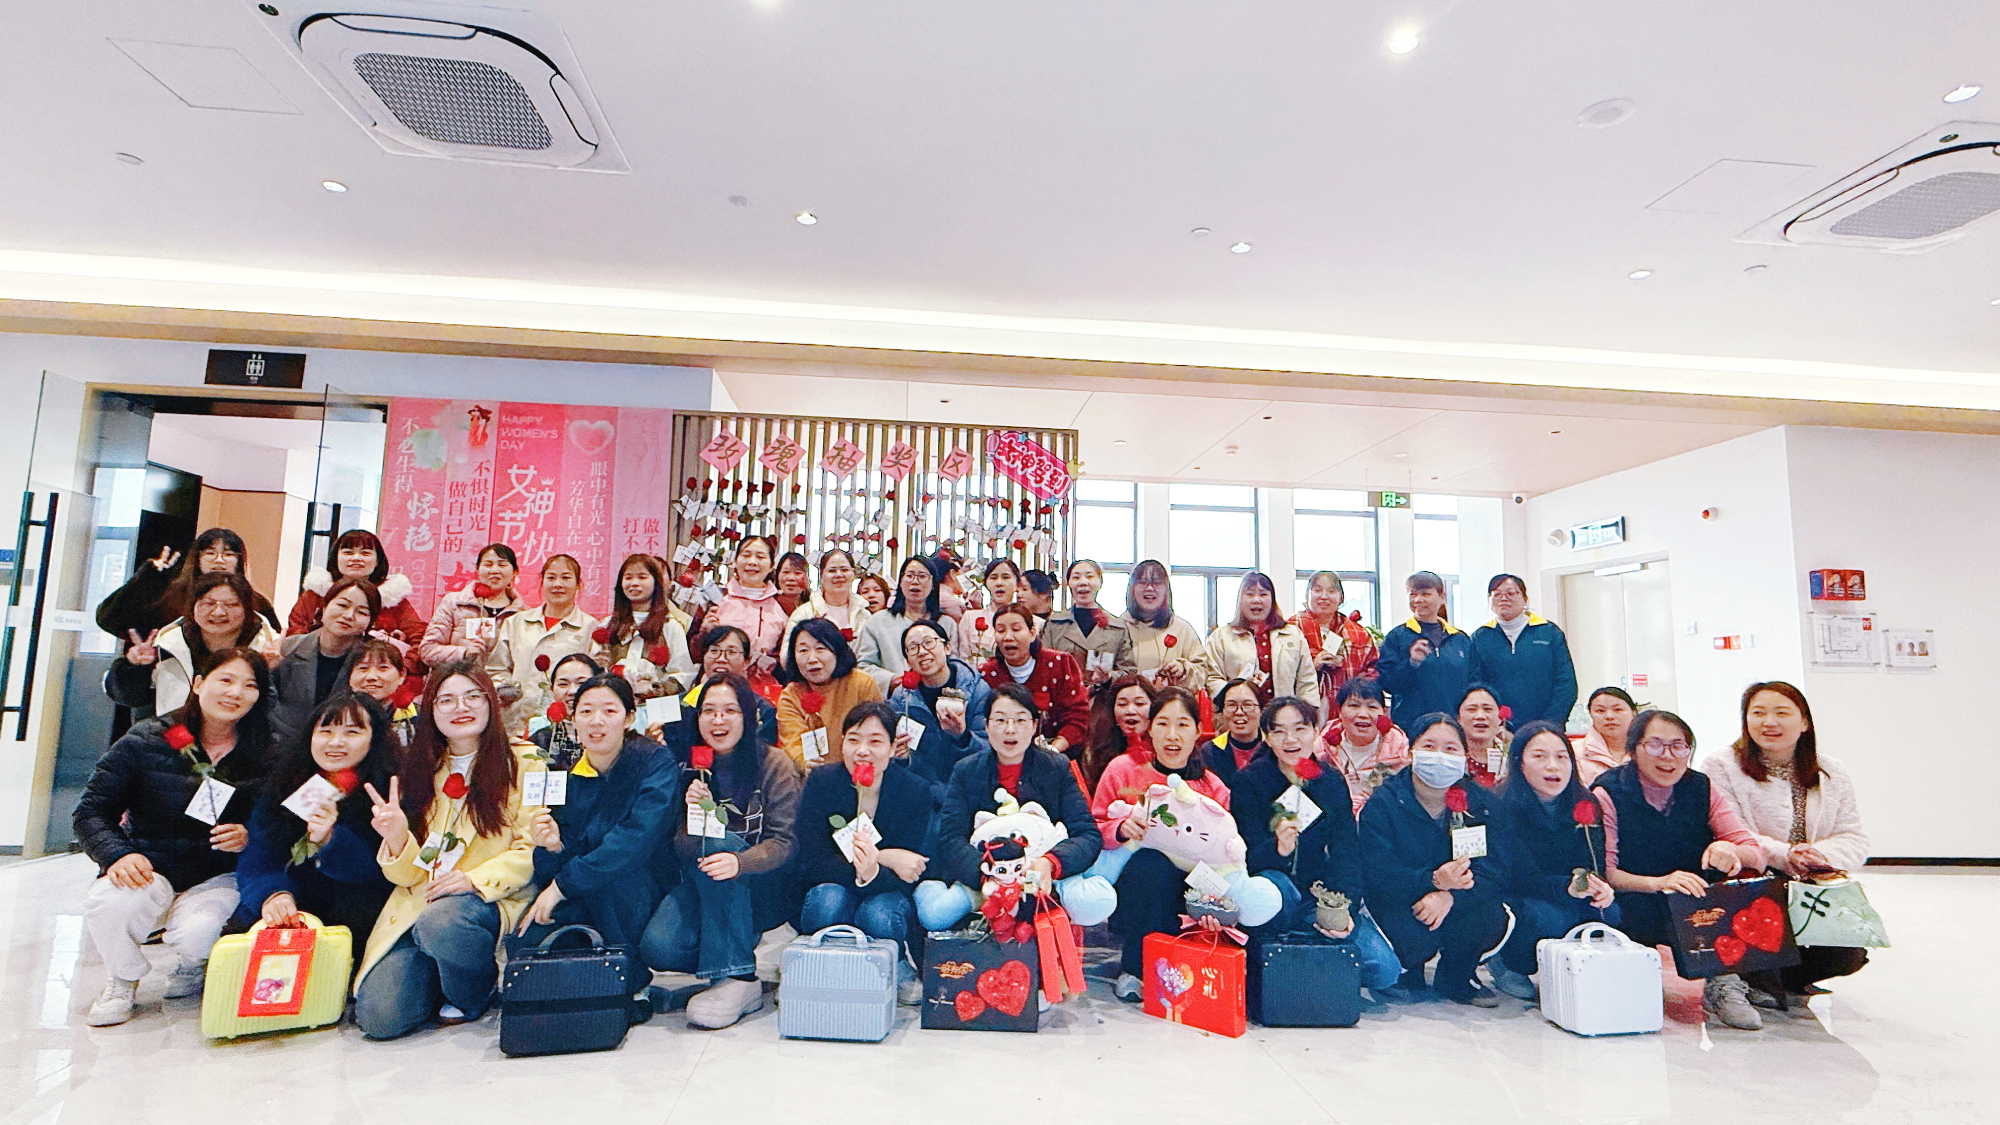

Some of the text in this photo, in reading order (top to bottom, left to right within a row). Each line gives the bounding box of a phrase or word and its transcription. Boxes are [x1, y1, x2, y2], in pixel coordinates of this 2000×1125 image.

[500, 440, 526, 450] DAY
[501, 428, 558, 439] WOMEN'S
[996, 438, 1070, 495] 女神驾到
[444, 481, 467, 553] 做自己的
[468, 460, 490, 532] 不惧时光
[403, 491, 439, 552] 惊艳
[644, 518, 660, 557] 做不
[1201, 967, 1218, 999] 心礼
